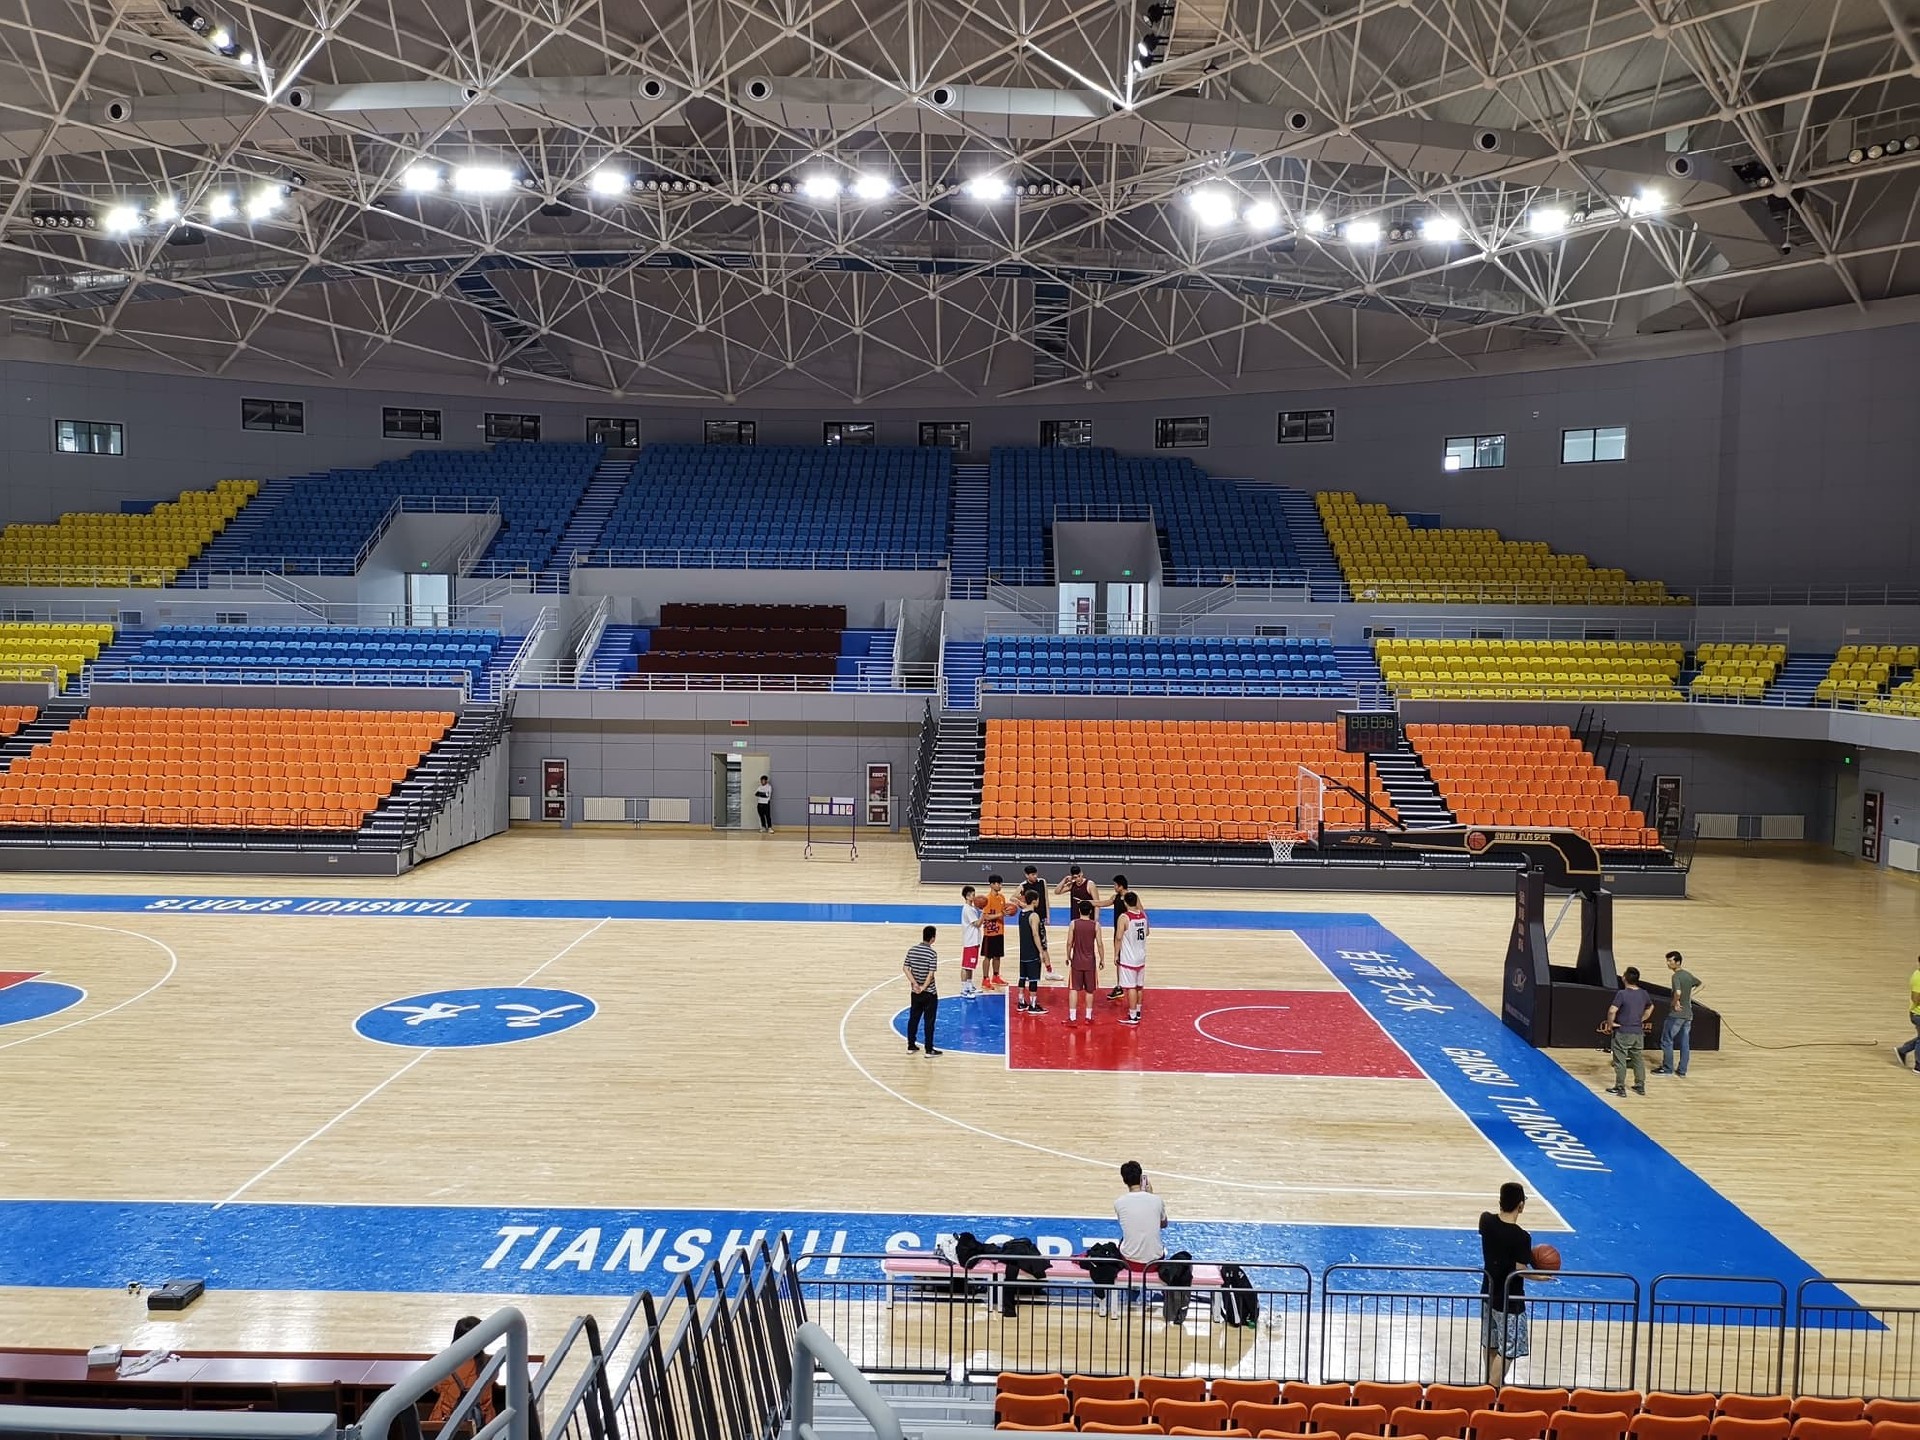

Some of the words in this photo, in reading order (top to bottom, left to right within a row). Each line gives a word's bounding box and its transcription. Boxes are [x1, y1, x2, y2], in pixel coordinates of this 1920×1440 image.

[145, 899, 293, 914] SPORTS
[294, 901, 472, 914] TIANSHUI
[1136, 928, 1145, 941] 15
[1336, 950, 1454, 1014] 甘肃天水
[1441, 1047, 1520, 1087] GANSU
[1487, 1095, 1613, 1172] TIANSHUI
